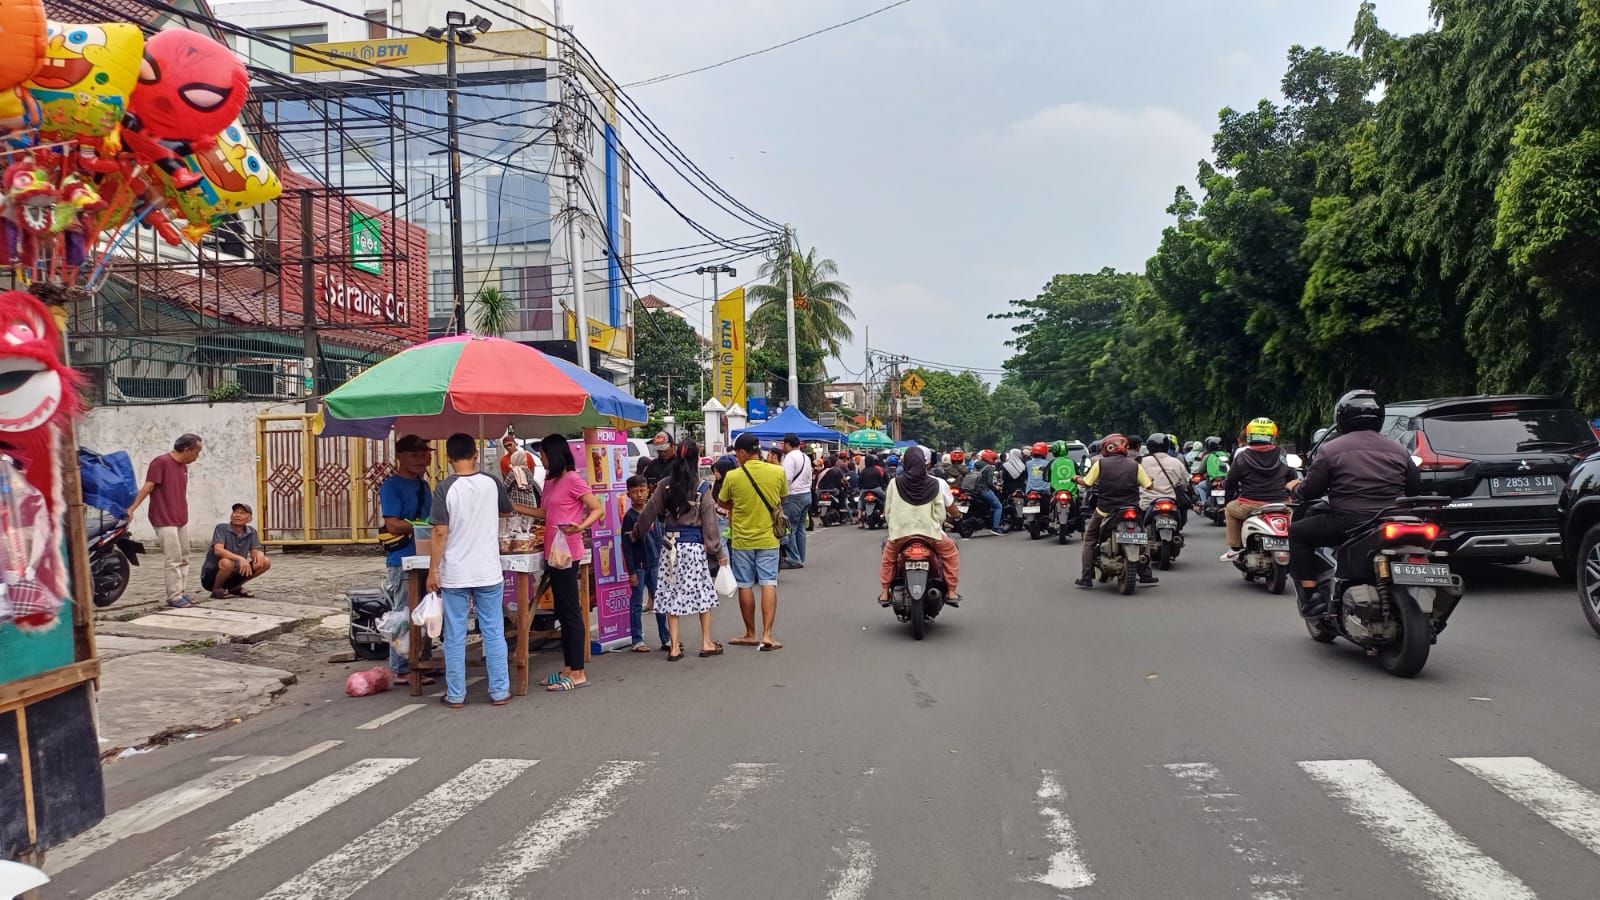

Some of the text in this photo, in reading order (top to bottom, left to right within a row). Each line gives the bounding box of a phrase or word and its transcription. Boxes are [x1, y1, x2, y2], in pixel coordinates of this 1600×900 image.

[377, 44, 408, 57] BTN
[324, 274, 380, 317] Sarang
[721, 320, 733, 398] Bank BTN
[597, 431, 616, 441] MENU
[1493, 478, 1500, 488] B
[1506, 477, 1530, 488] 2853
[1394, 566, 1401, 574] B
[1405, 566, 1427, 575] 6294
